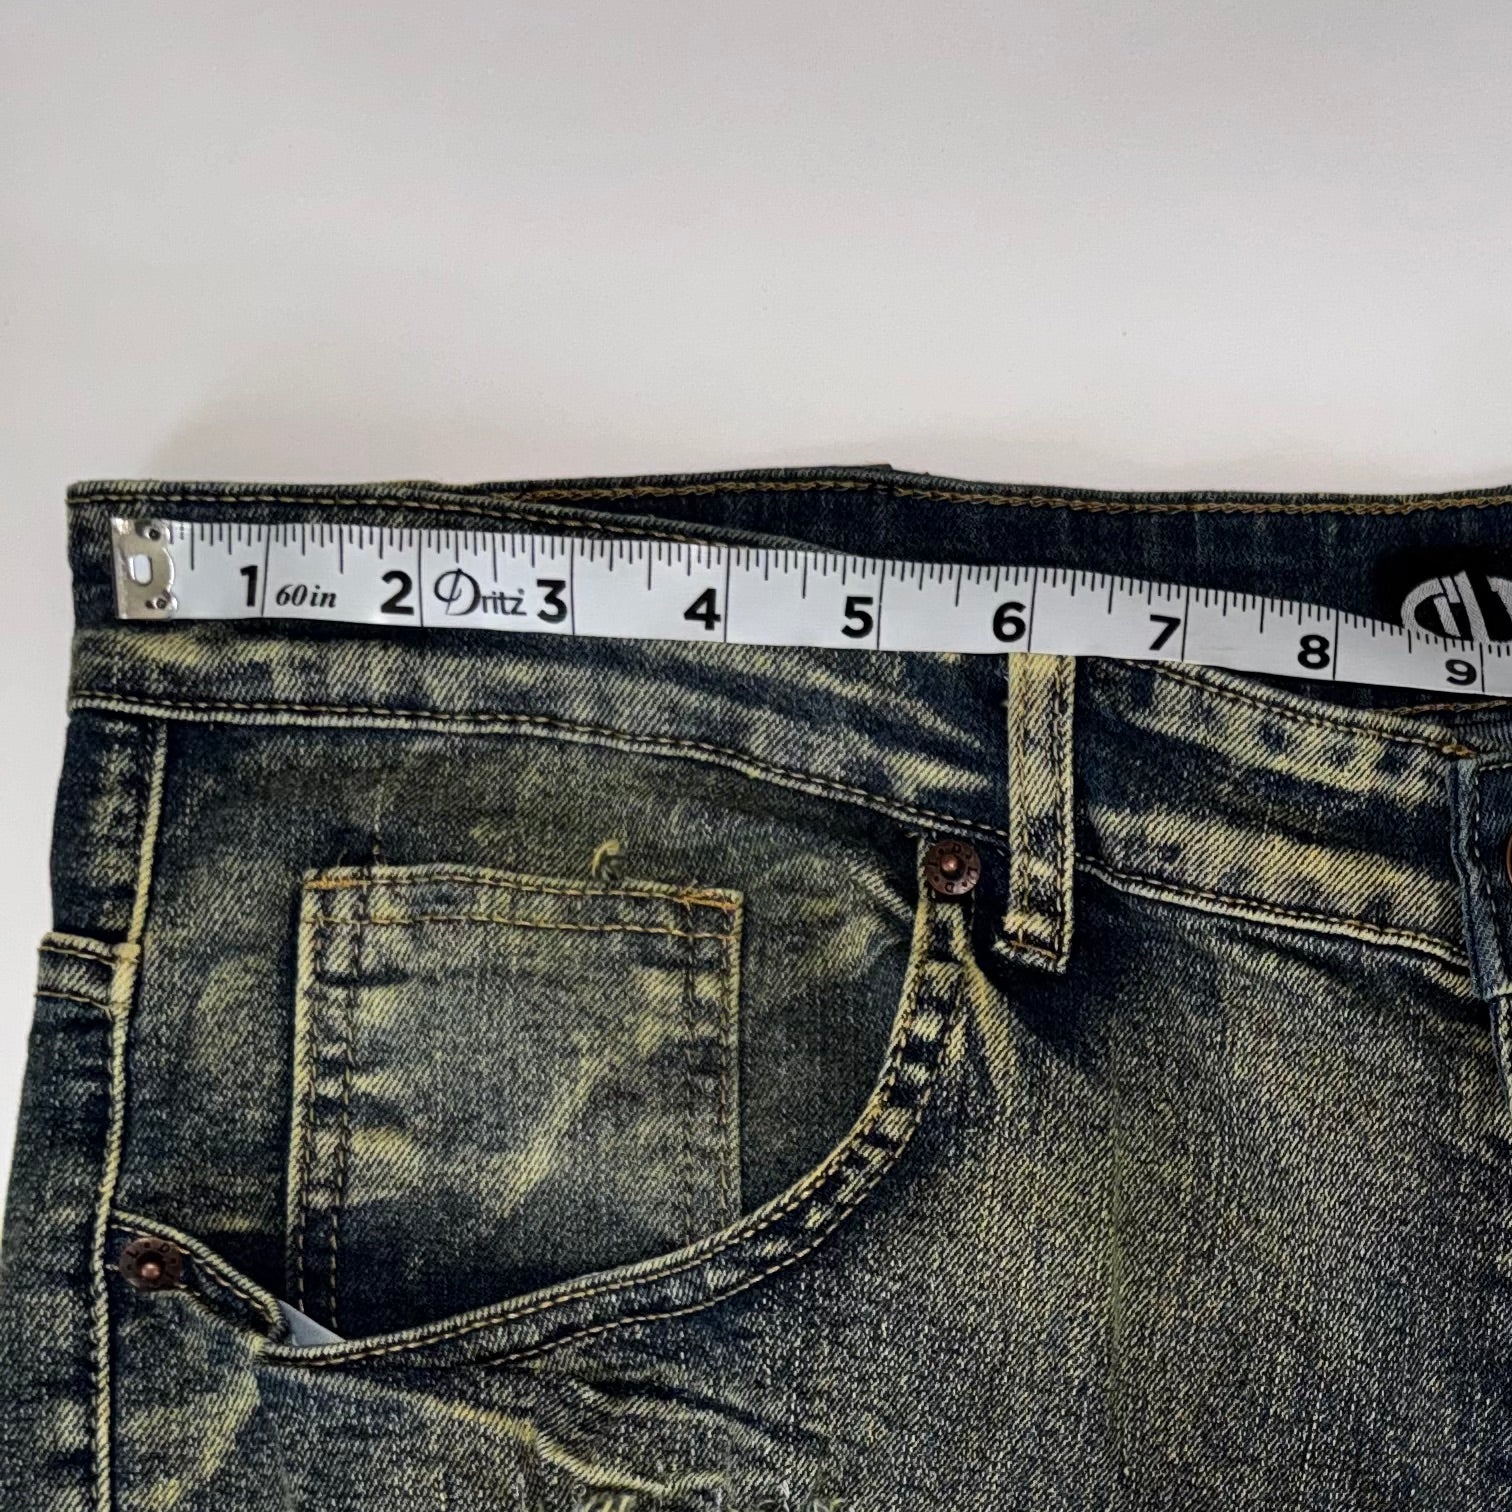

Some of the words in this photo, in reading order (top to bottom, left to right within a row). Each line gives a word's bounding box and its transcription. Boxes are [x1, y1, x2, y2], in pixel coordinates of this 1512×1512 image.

[240, 566, 259, 607] 1
[381, 570, 414, 617] 2
[536, 578, 569, 624] 3
[683, 588, 722, 631] 4
[841, 596, 874, 639] 5
[993, 601, 1027, 643] 6
[1149, 614, 1181, 652] 7
[1297, 634, 1331, 670] 8
[1445, 659, 1478, 686] 9
